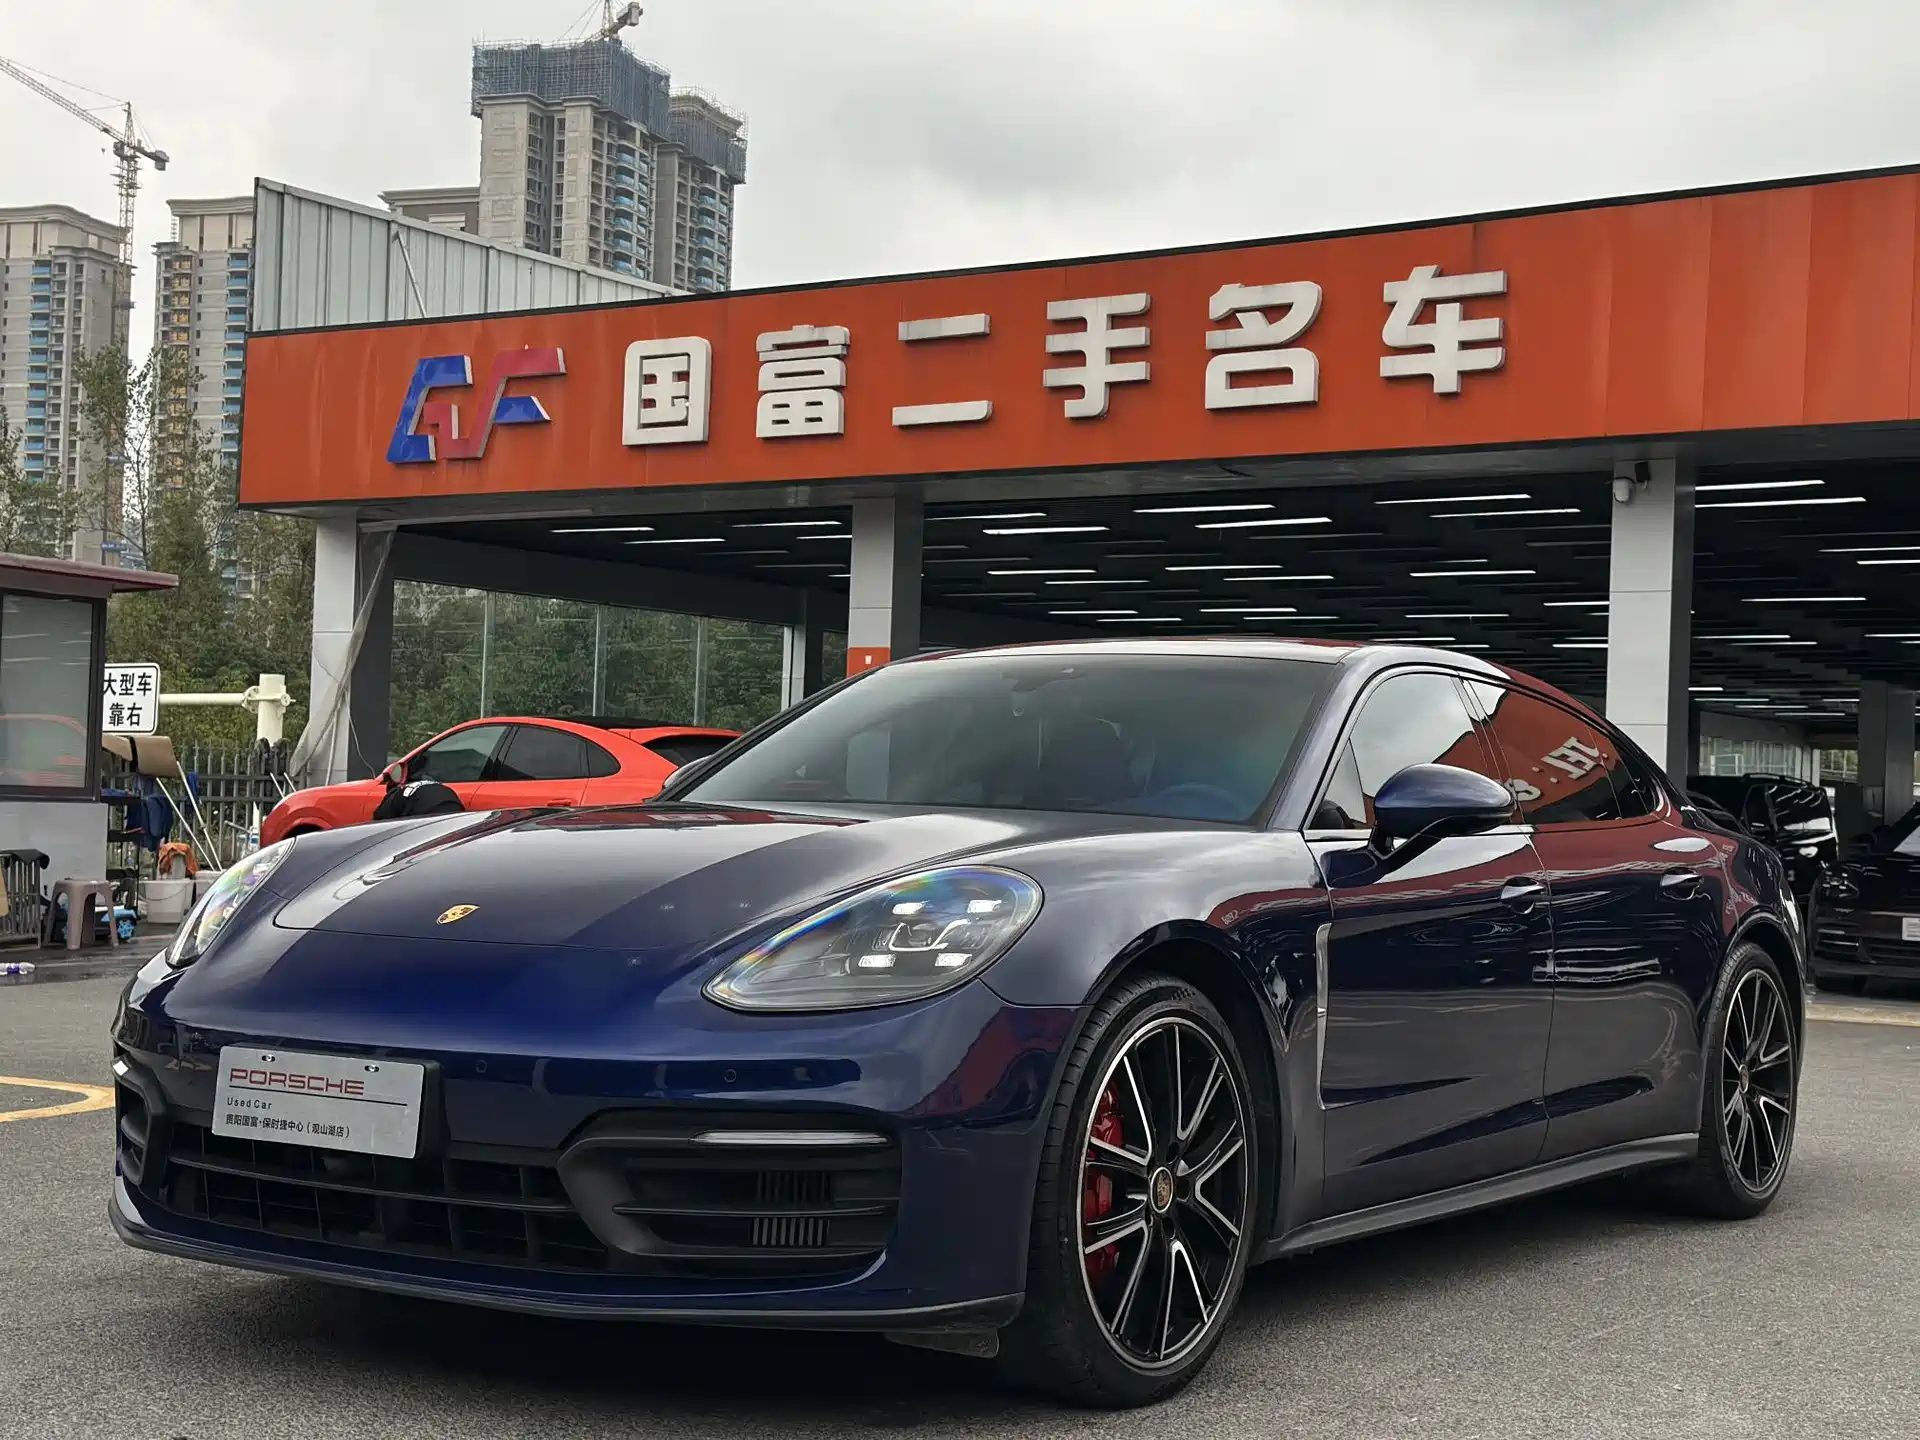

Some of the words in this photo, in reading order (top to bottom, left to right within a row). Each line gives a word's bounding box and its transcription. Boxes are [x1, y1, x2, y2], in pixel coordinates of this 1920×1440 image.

[622, 265, 1508, 446] 国富二手名车
[104, 672, 152, 696] 大型车
[108, 702, 143, 727] 靠右
[229, 1068, 364, 1095] PORSCHE
[227, 1097, 252, 1108] Used
[253, 1099, 273, 1110] Car
